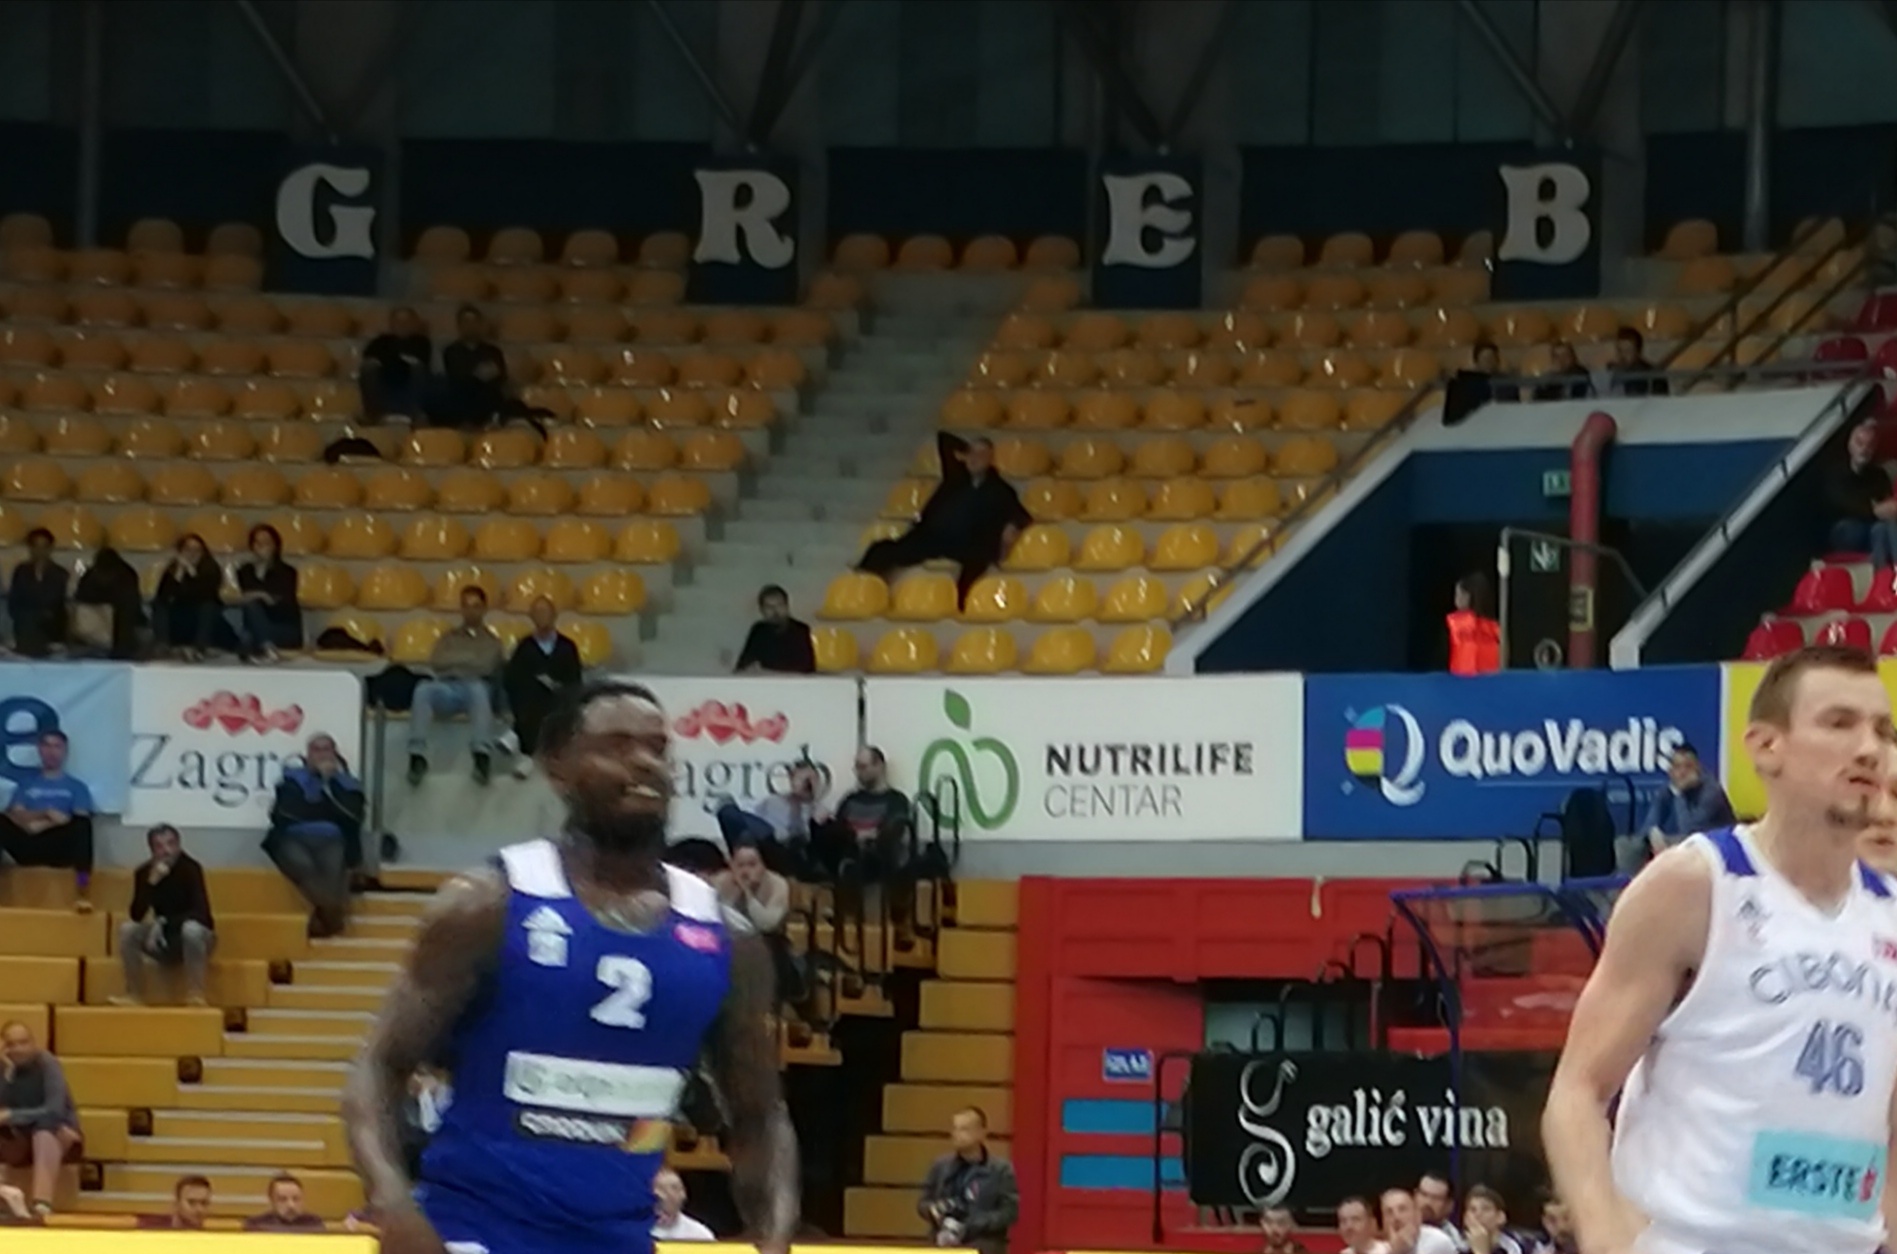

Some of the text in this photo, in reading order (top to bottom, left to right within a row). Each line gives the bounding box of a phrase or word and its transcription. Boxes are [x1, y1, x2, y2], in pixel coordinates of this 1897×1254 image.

[274, 161, 1592, 270] G R E B
[1044, 743, 1254, 776] NUTRILIFE
[1439, 716, 1686, 781] QuoVadis
[1044, 783, 1184, 817] CENTAR
[589, 953, 653, 1030] 2
[1794, 1018, 1865, 1097] 46
[1305, 1088, 1509, 1158] galić vina
